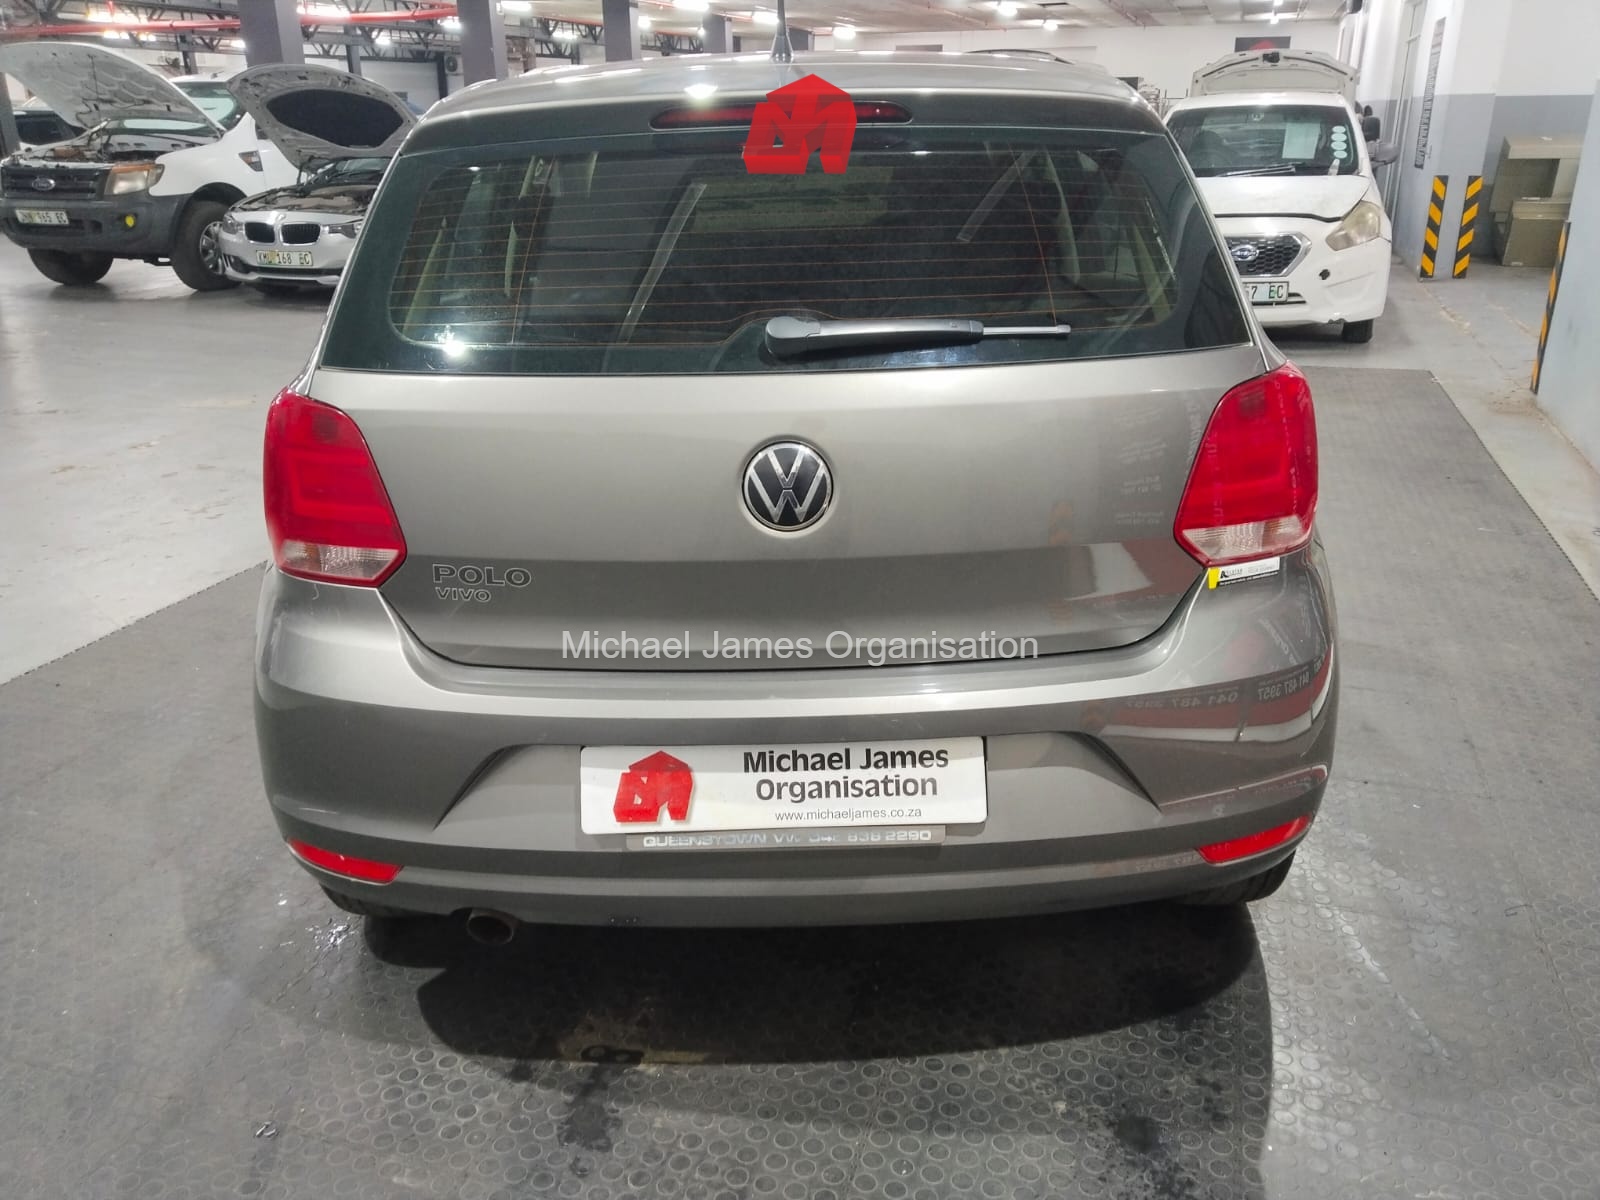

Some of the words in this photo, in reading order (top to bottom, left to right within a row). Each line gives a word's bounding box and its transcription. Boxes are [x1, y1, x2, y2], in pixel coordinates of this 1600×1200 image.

[299, 252, 310, 265] EC
[1269, 284, 1284, 299] EC
[432, 563, 532, 588] POLO
[435, 586, 492, 603] VIVO
[743, 748, 850, 773] Michael
[859, 748, 949, 770] James
[755, 774, 938, 804] Organisation
[774, 808, 922, 822] www.michaeljames.co.za
[885, 829, 932, 842] 2290
